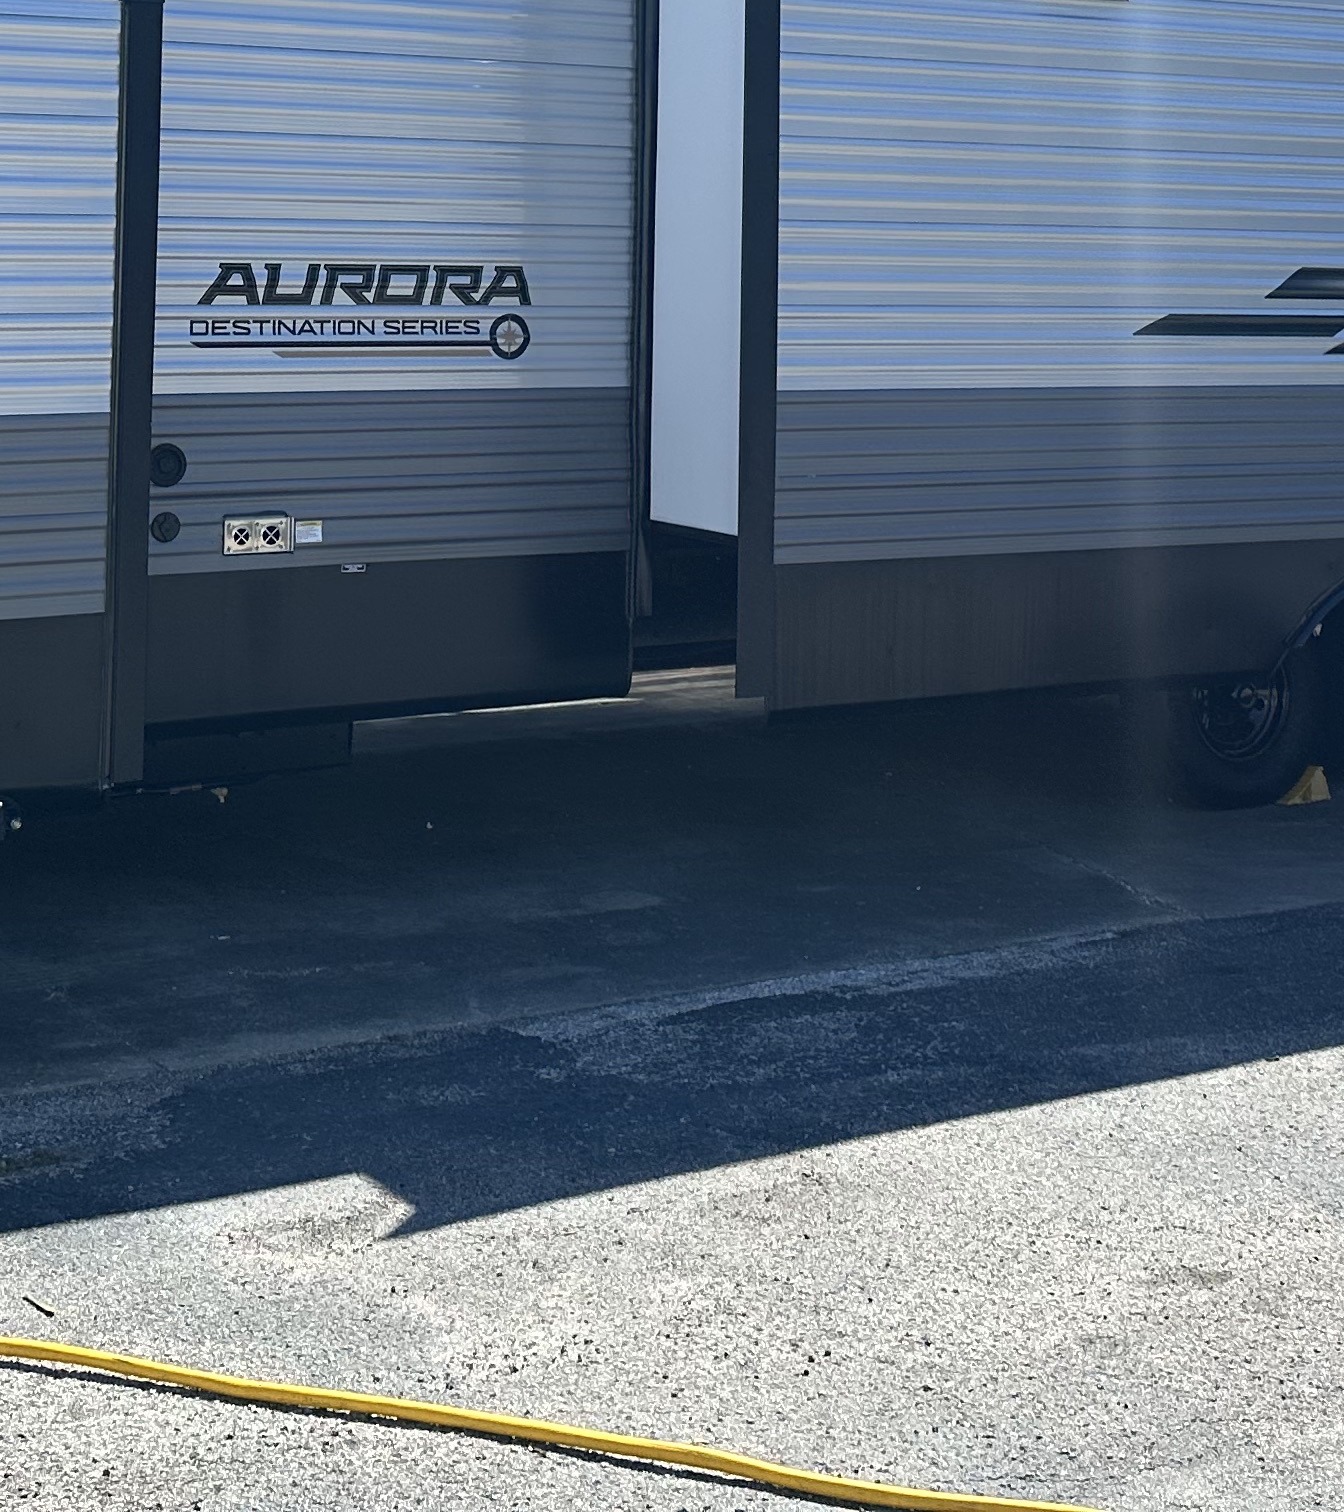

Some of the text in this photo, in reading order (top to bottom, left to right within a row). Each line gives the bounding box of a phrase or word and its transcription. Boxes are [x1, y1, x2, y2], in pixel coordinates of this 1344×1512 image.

[196, 262, 532, 306] AURORA
[189, 319, 481, 337] DESTINATION SERIES
